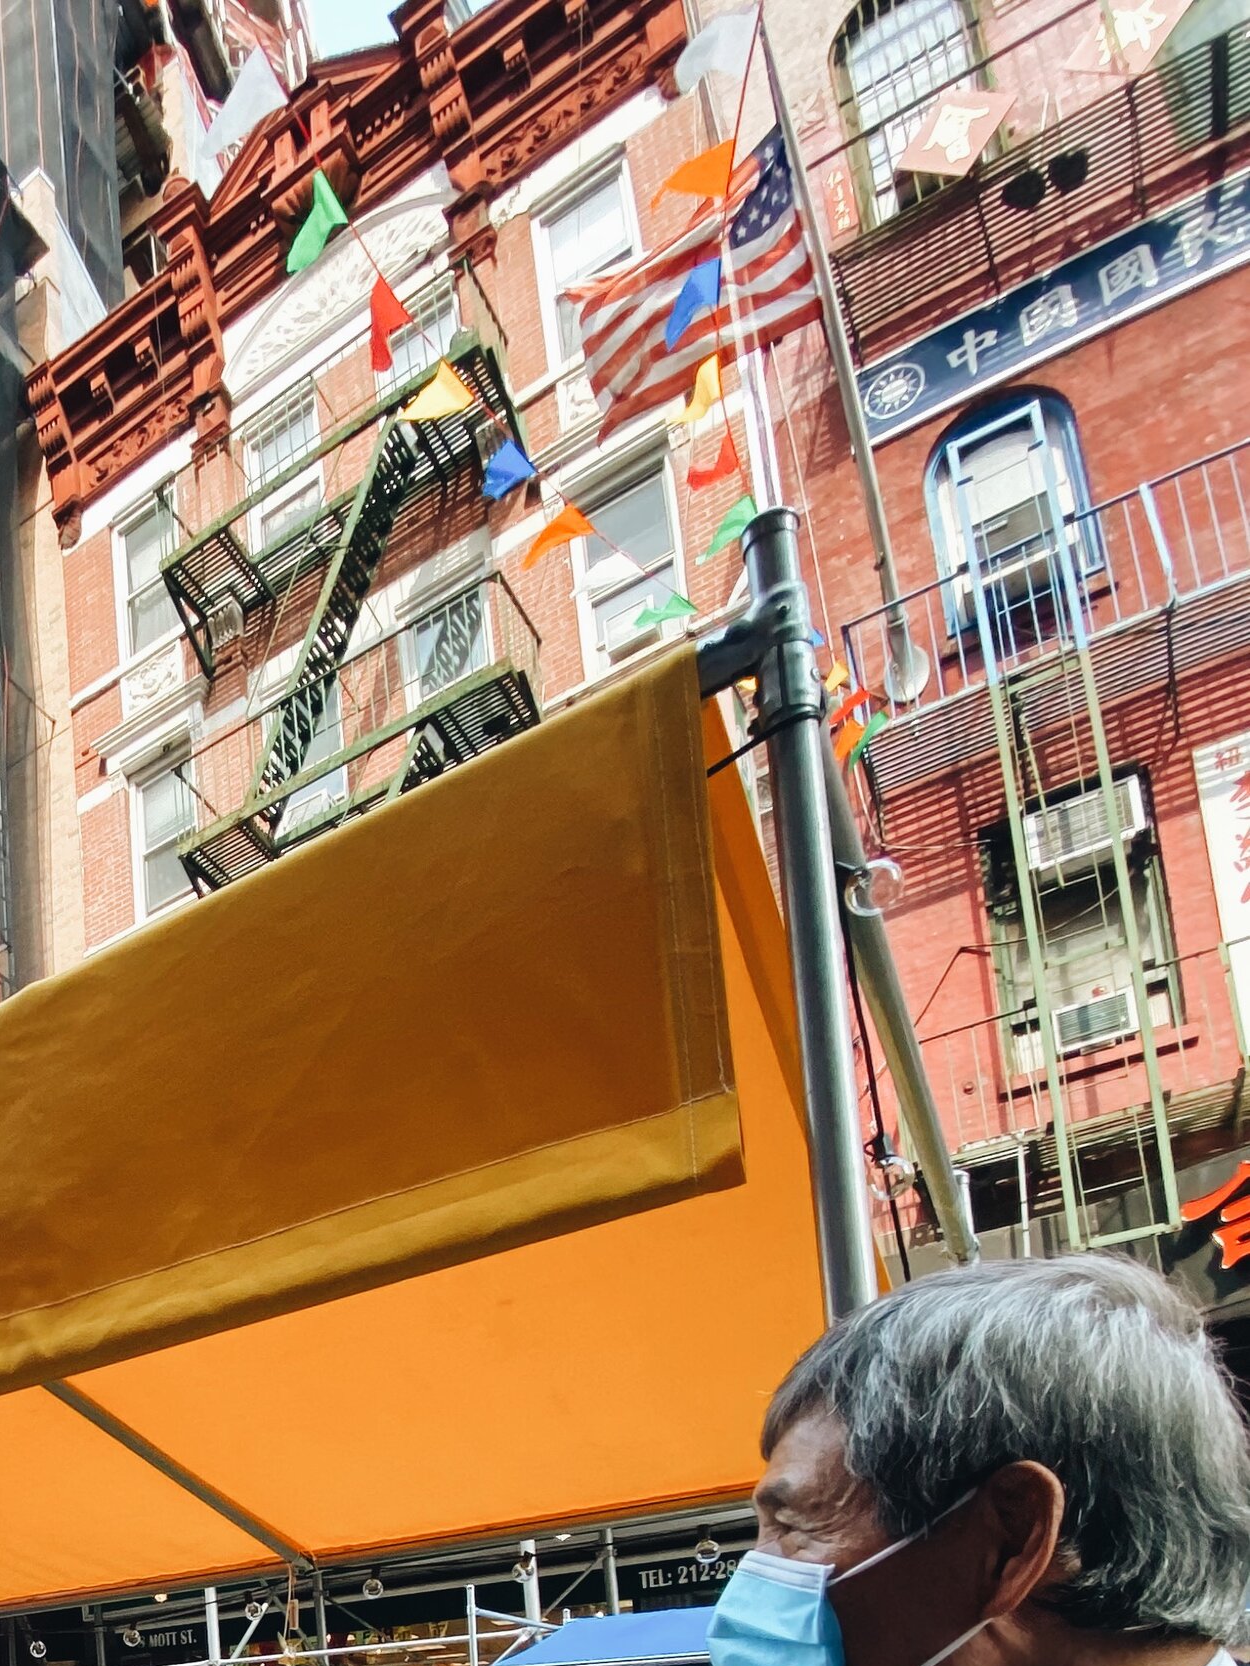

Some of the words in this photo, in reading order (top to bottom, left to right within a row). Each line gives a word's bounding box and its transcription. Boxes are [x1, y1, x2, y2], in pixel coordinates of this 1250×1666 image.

[638, 1568, 673, 1589] TEL:
[149, 1631, 178, 1648] MOTT
[180, 1629, 197, 1645] ST.
